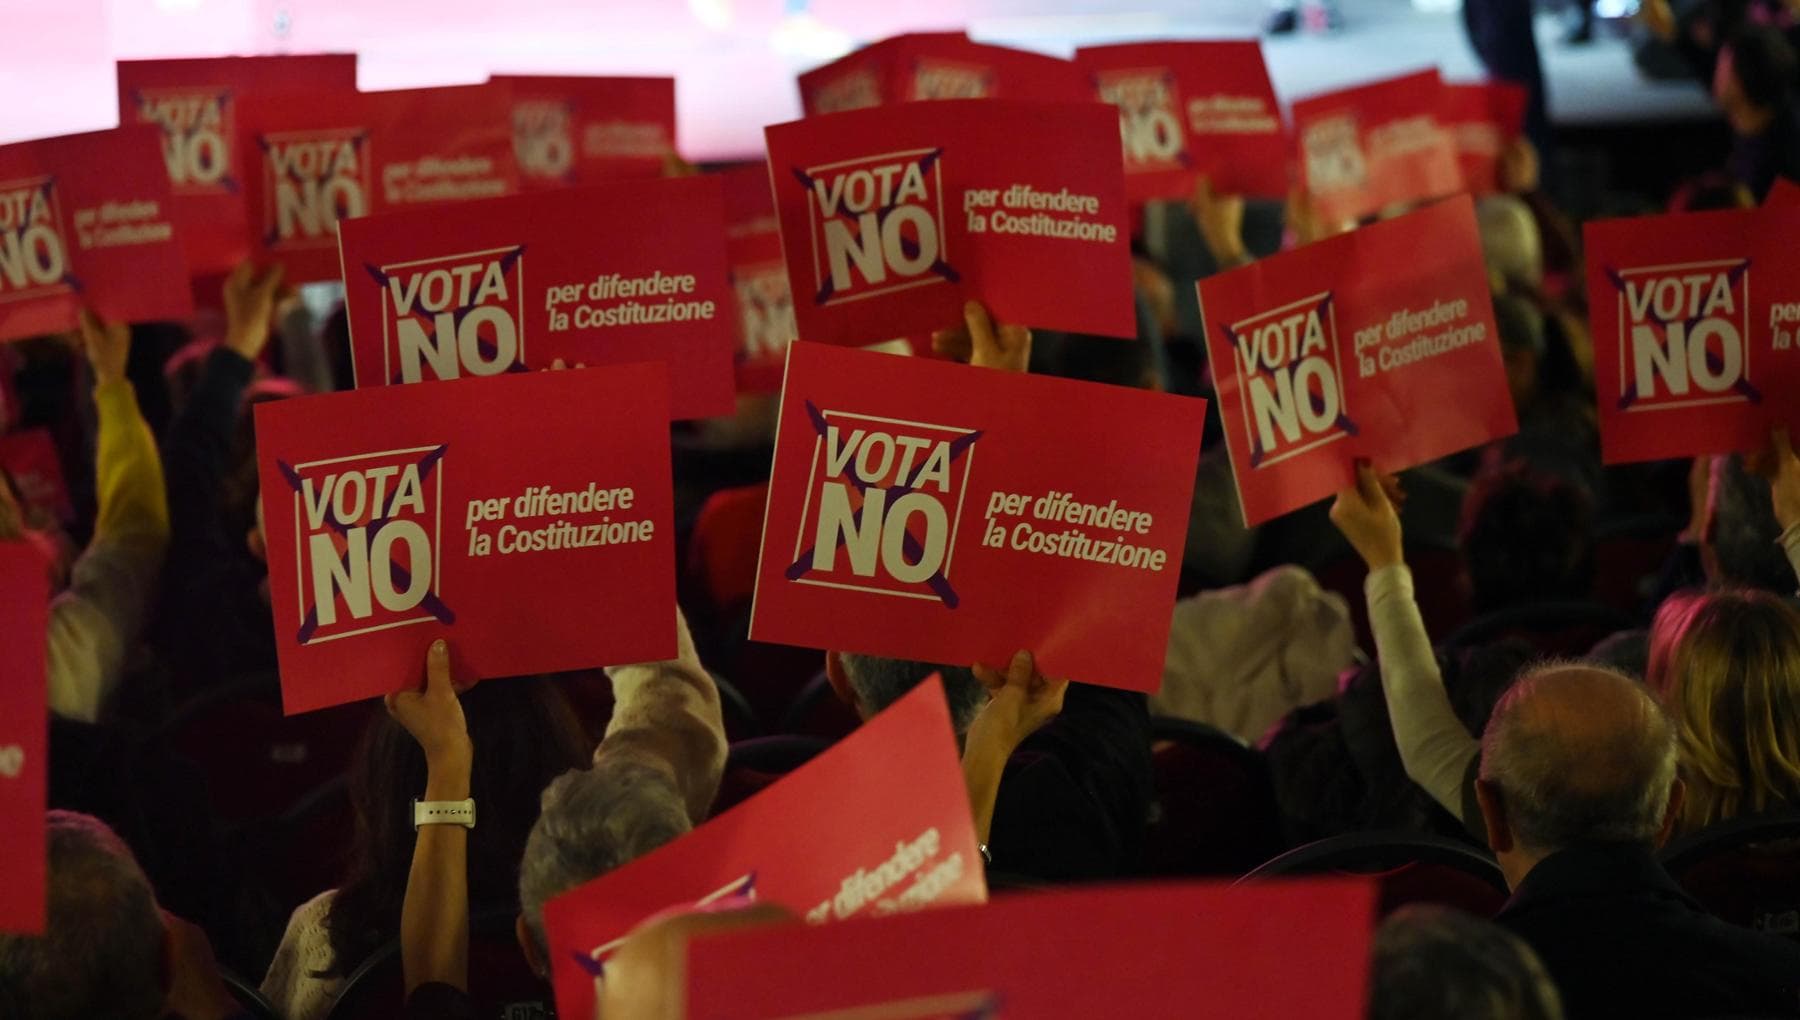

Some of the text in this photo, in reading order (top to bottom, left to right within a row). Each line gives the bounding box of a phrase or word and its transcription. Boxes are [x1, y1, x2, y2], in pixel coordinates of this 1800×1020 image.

[269, 141, 358, 176] VOTA
[0, 189, 51, 233] OTA
[277, 176, 368, 238] NO
[815, 162, 927, 218] VOTA
[964, 185, 1099, 214] per difendere
[825, 205, 938, 290] NO
[967, 210, 1116, 242] la Costituzione
[390, 261, 508, 317] VOTA
[546, 271, 695, 312] per difendere
[549, 298, 714, 331] la Costituzione
[1626, 273, 1734, 320] VOTA
[397, 306, 518, 384] NO
[1238, 310, 1325, 379] VOTA
[1355, 299, 1467, 358] per difendere
[1359, 323, 1485, 377] la Costituzione
[1632, 318, 1742, 398] NO
[1248, 357, 1339, 452] NO
[827, 426, 950, 492] VOTA
[302, 464, 424, 530] VOTA
[466, 482, 633, 529] per difendere
[985, 491, 1152, 534] per difendere
[467, 517, 654, 556] la Costituzione
[812, 482, 948, 583] NO
[982, 518, 1166, 571] la Costituzione
[310, 520, 432, 626] NO
